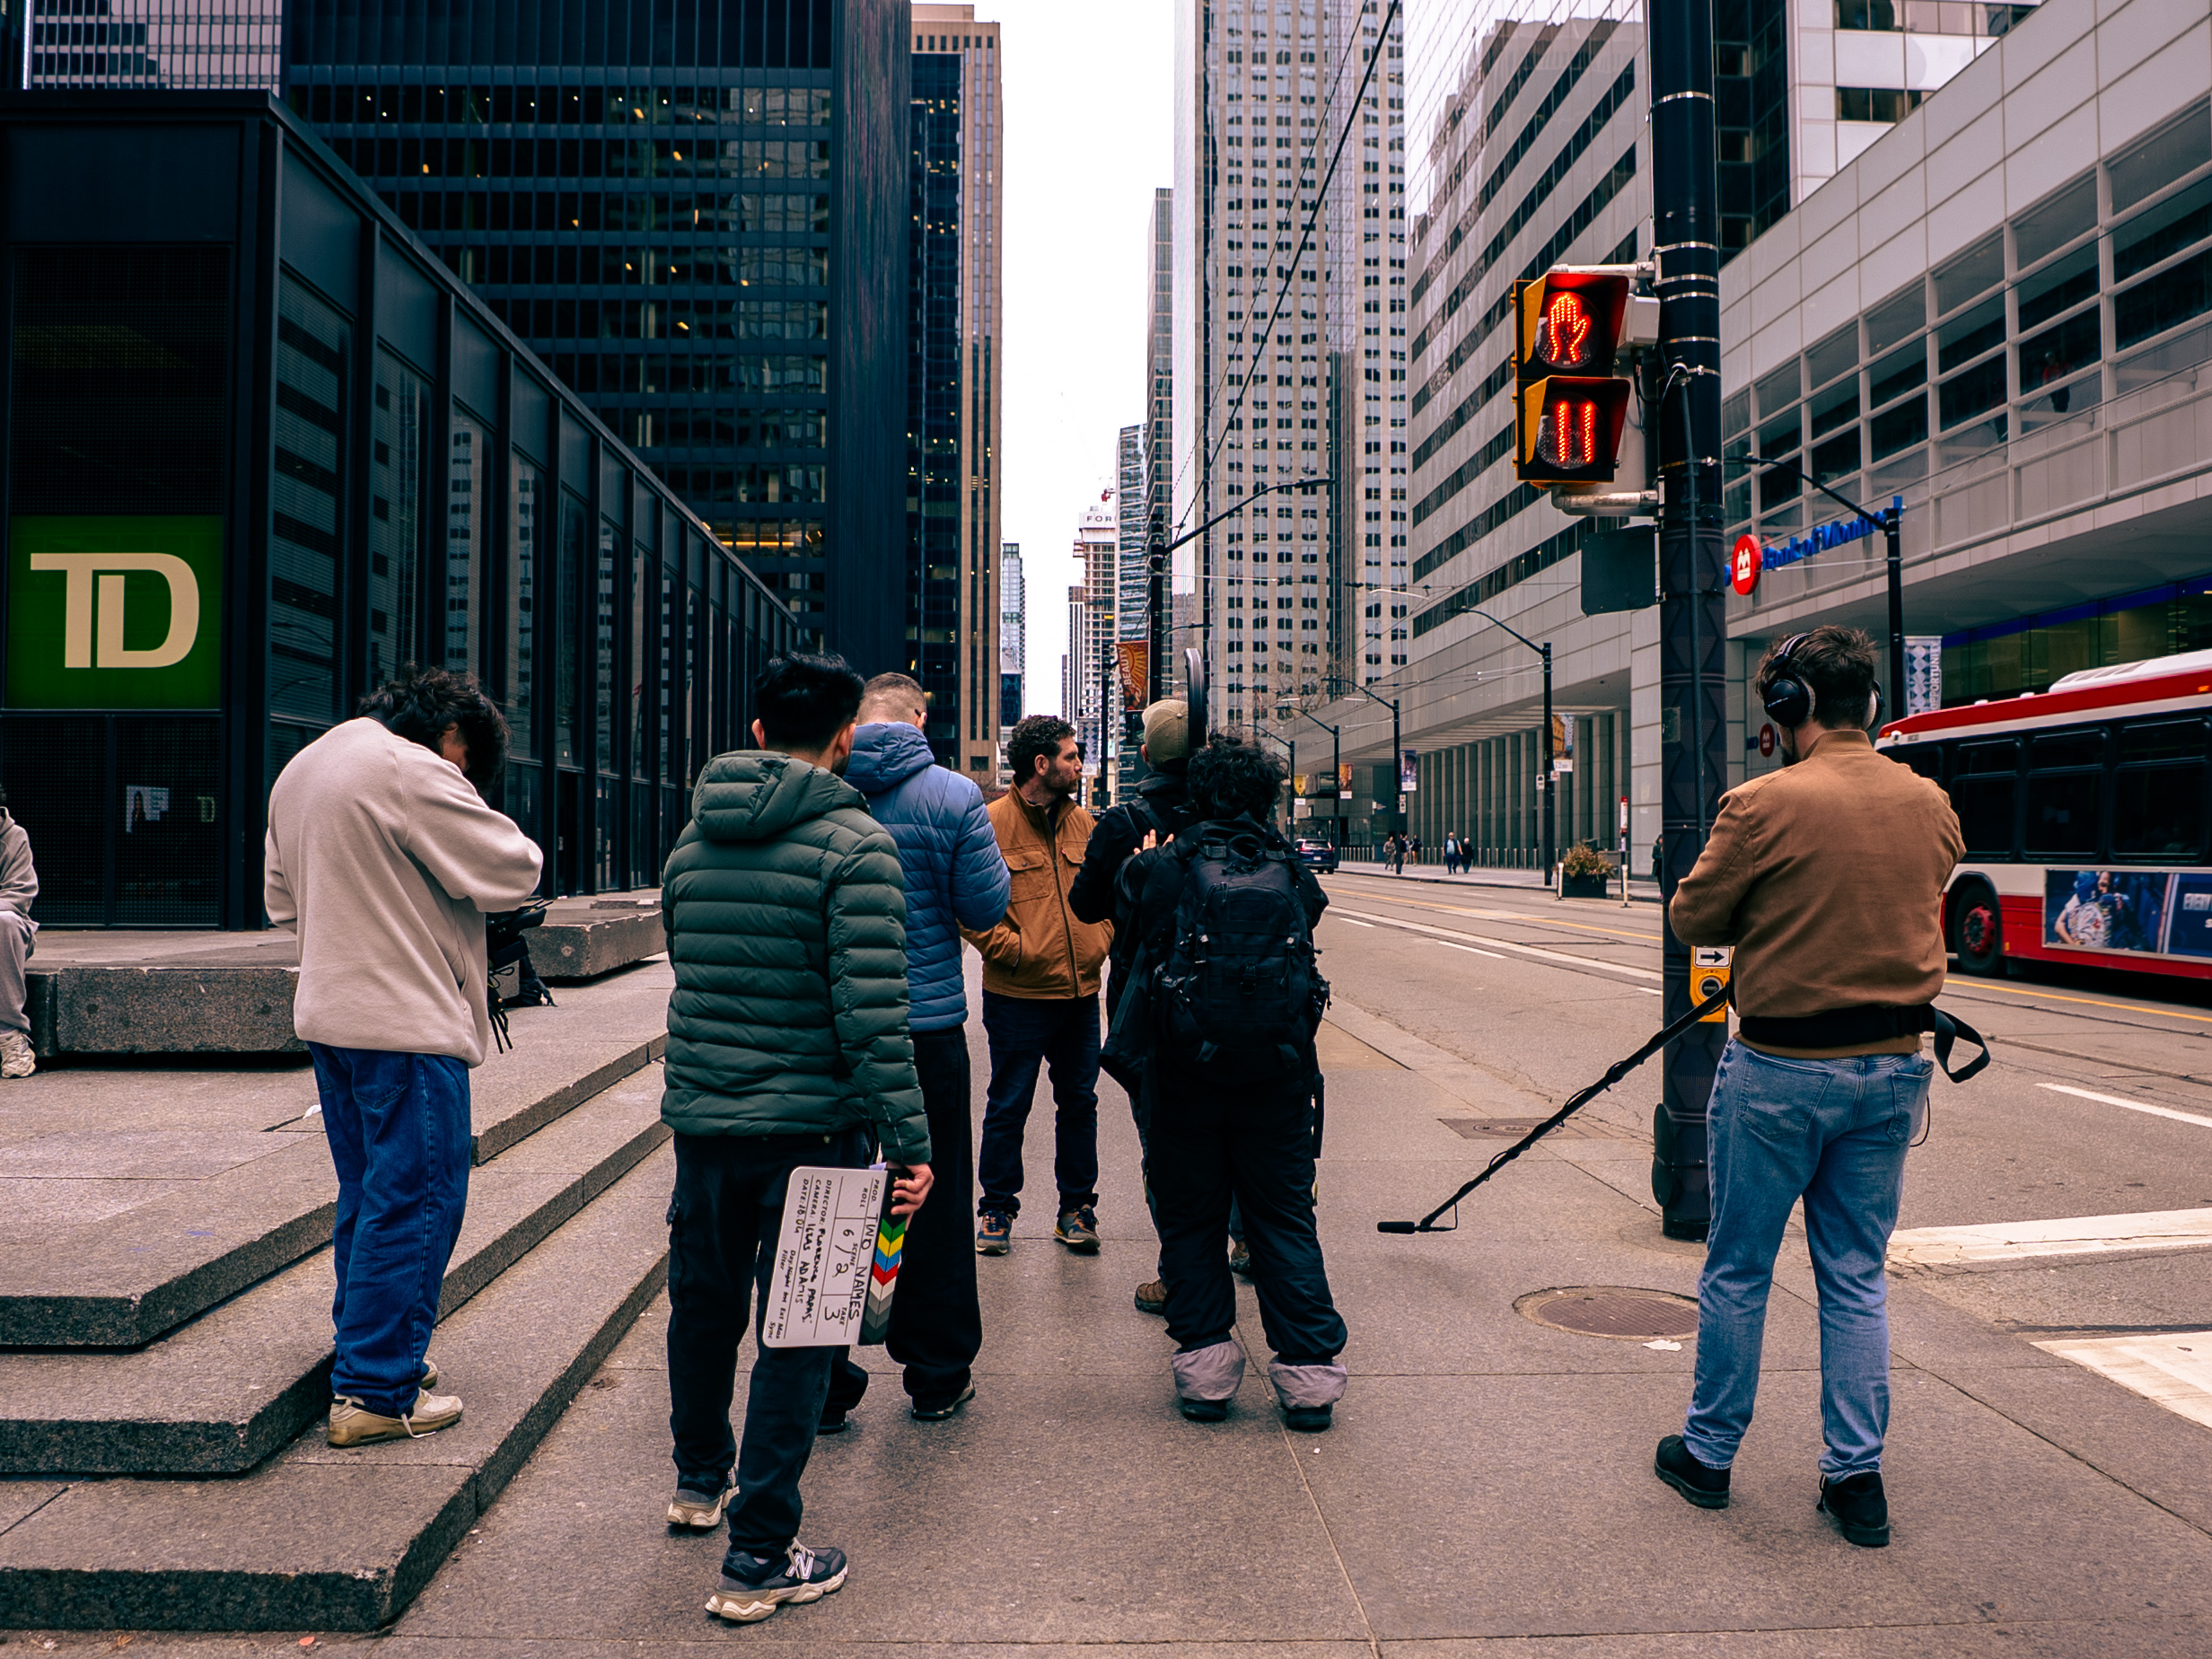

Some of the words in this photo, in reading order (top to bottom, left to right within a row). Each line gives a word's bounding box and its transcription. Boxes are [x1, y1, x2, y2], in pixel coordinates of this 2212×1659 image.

[1762, 536, 1802, 570] Bank
[1801, 527, 1822, 557] of
[30, 552, 200, 669] TD
[1118, 646, 1132, 686] BEAUTY
[1929, 640, 1941, 710] OPPORTUNITY
[859, 1187, 868, 1207] ROLL
[861, 1213, 879, 1251] TWO
[849, 1242, 859, 1266] SCENE
[848, 1265, 868, 1321] NAMES
[824, 1306, 840, 1321] 3
[838, 1306, 847, 1326] TAKE
